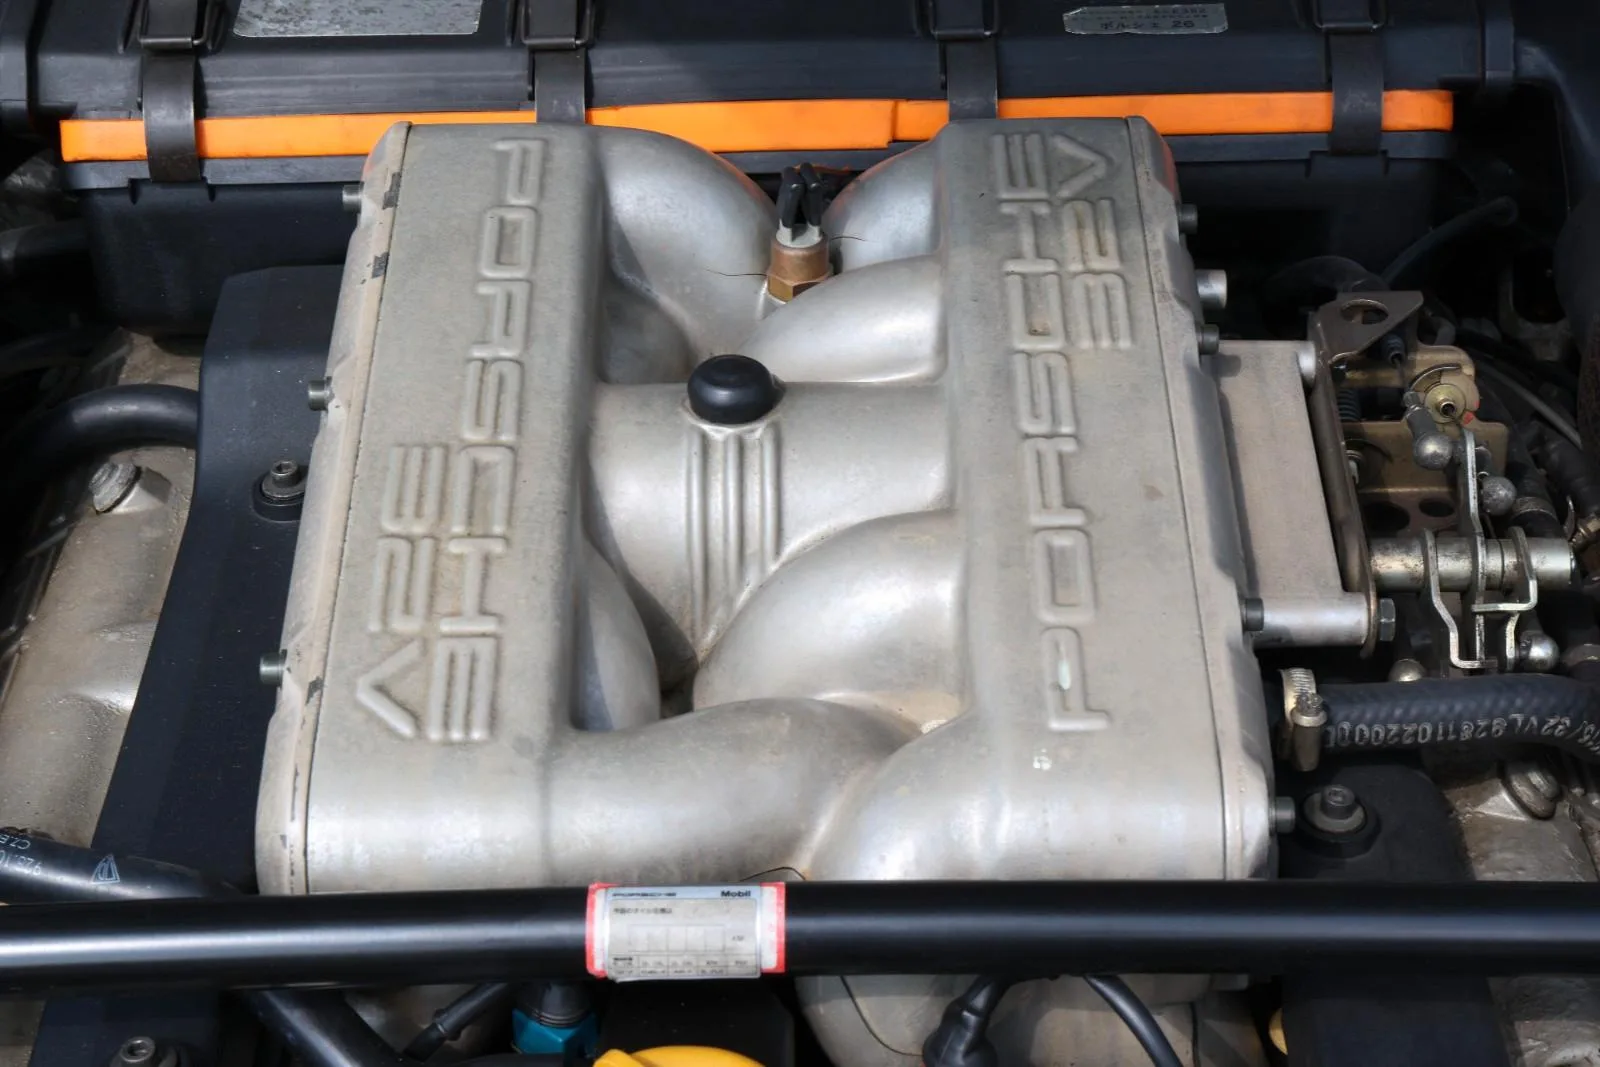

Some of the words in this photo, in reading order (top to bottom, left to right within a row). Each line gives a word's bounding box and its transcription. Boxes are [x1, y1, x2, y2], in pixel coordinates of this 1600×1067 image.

[1054, 132, 1133, 350] 32V
[425, 137, 550, 743] PORSCHE
[991, 131, 1113, 732] PORSCHE
[355, 442, 450, 741] 32V
[720, 890, 752, 898] Mobil
